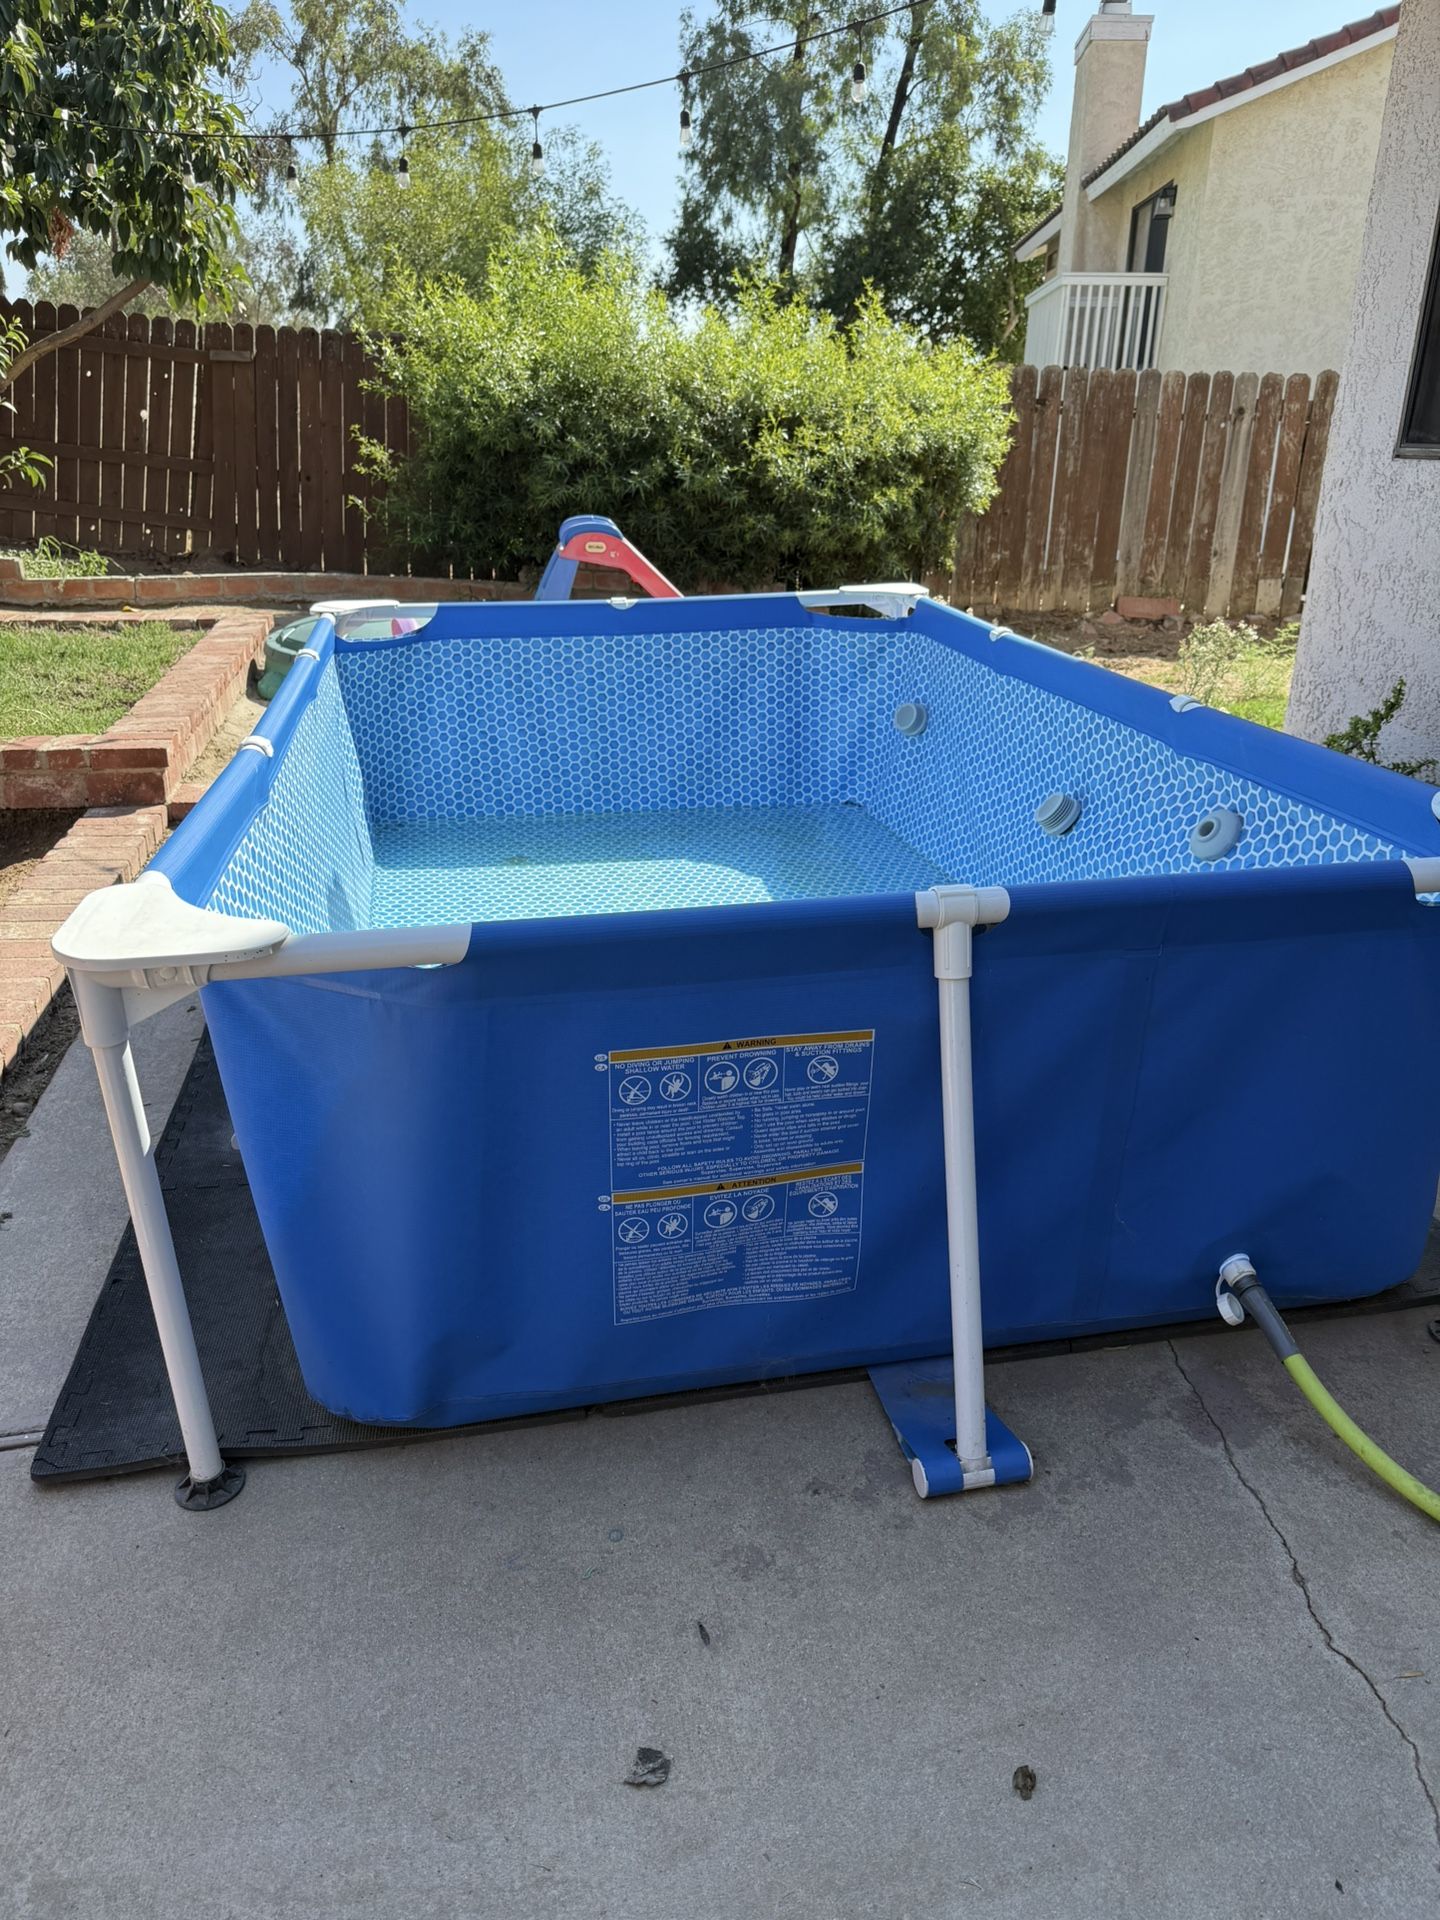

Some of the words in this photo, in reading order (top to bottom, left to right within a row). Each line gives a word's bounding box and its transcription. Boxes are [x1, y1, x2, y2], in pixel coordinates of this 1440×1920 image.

[736, 1038, 777, 1048] WARNING
[706, 1053, 738, 1062] PREVENT
[739, 1049, 777, 1058] DROWNING
[627, 1060, 650, 1068] DIVING
[664, 1057, 695, 1065] JUMPING
[625, 1066, 659, 1074] SHALLOW
[732, 1177, 777, 1189] ATTENTION
